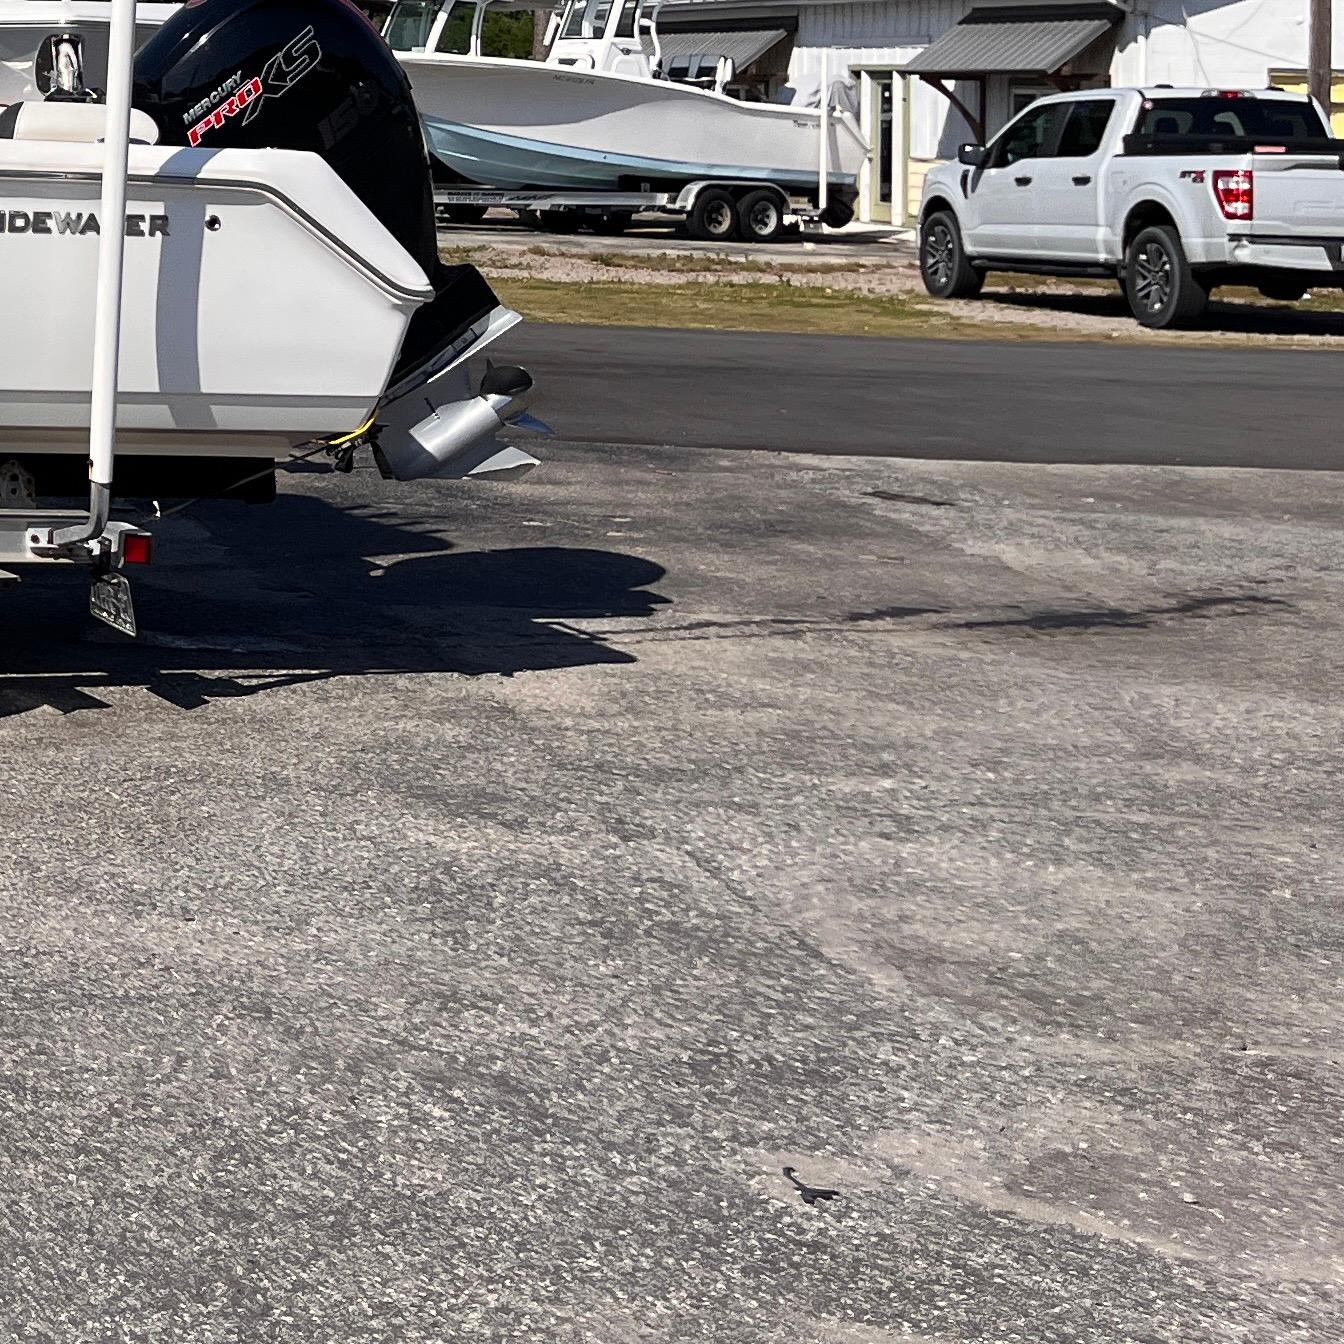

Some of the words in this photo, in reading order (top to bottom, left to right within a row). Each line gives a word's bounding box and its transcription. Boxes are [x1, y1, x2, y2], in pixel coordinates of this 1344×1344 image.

[182, 70, 243, 125] MERCURY
[186, 76, 263, 148] PRO
[234, 24, 323, 127] XS
